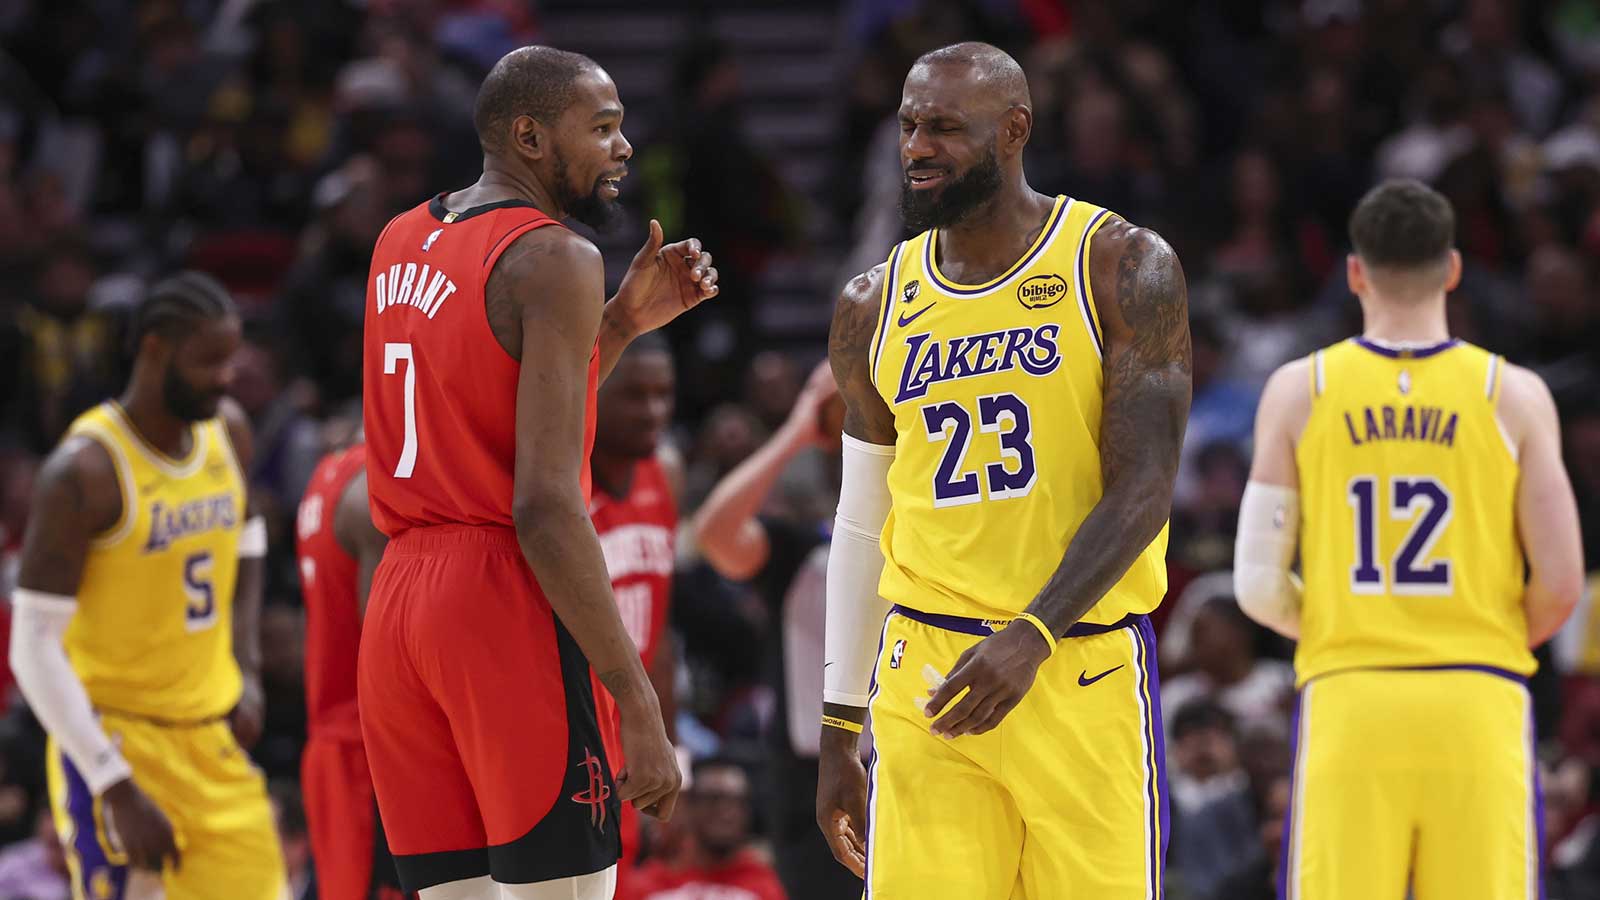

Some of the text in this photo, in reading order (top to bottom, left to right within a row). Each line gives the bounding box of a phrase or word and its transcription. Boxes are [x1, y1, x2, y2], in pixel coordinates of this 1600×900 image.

[376, 262, 457, 319] DURANT
[1022, 283, 1064, 297] bibigo
[895, 323, 1062, 404] LAKERS
[384, 343, 418, 478] 7
[920, 391, 1038, 509] 23
[1344, 405, 1459, 448] LARAVIA
[1348, 475, 1453, 597] 12
[184, 551, 219, 633] 5
